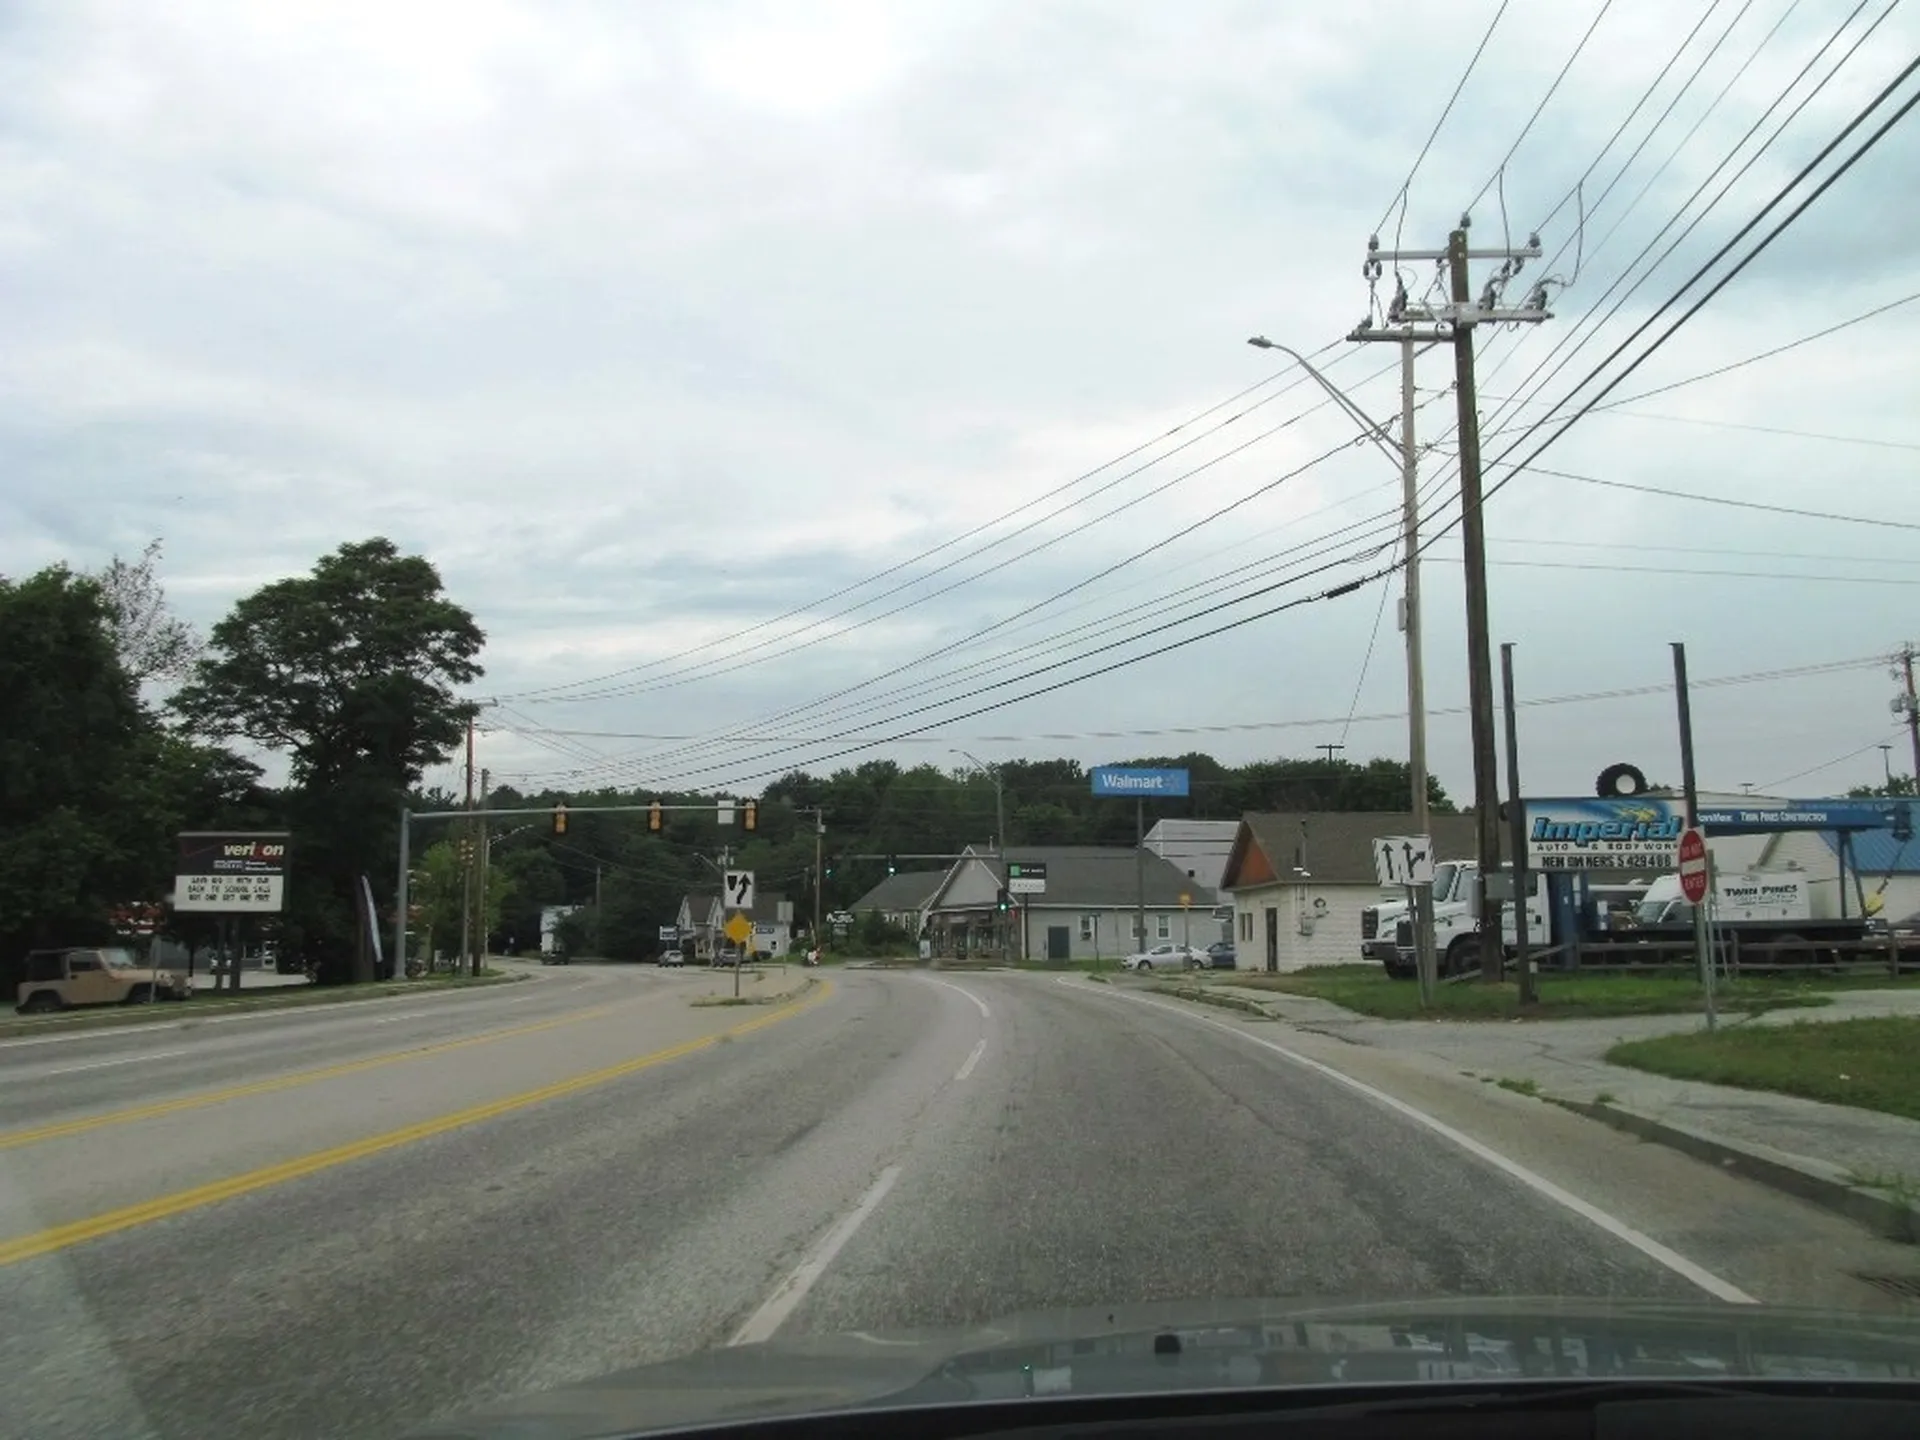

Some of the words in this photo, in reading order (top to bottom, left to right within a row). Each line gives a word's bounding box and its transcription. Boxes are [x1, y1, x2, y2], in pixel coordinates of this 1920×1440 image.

[1102, 774, 1163, 788] Walmart
[1530, 816, 1683, 847] Imperial
[1537, 843, 1568, 851] AUTO
[1723, 887, 1758, 897] TWIN
[1761, 884, 1798, 895] PINES
